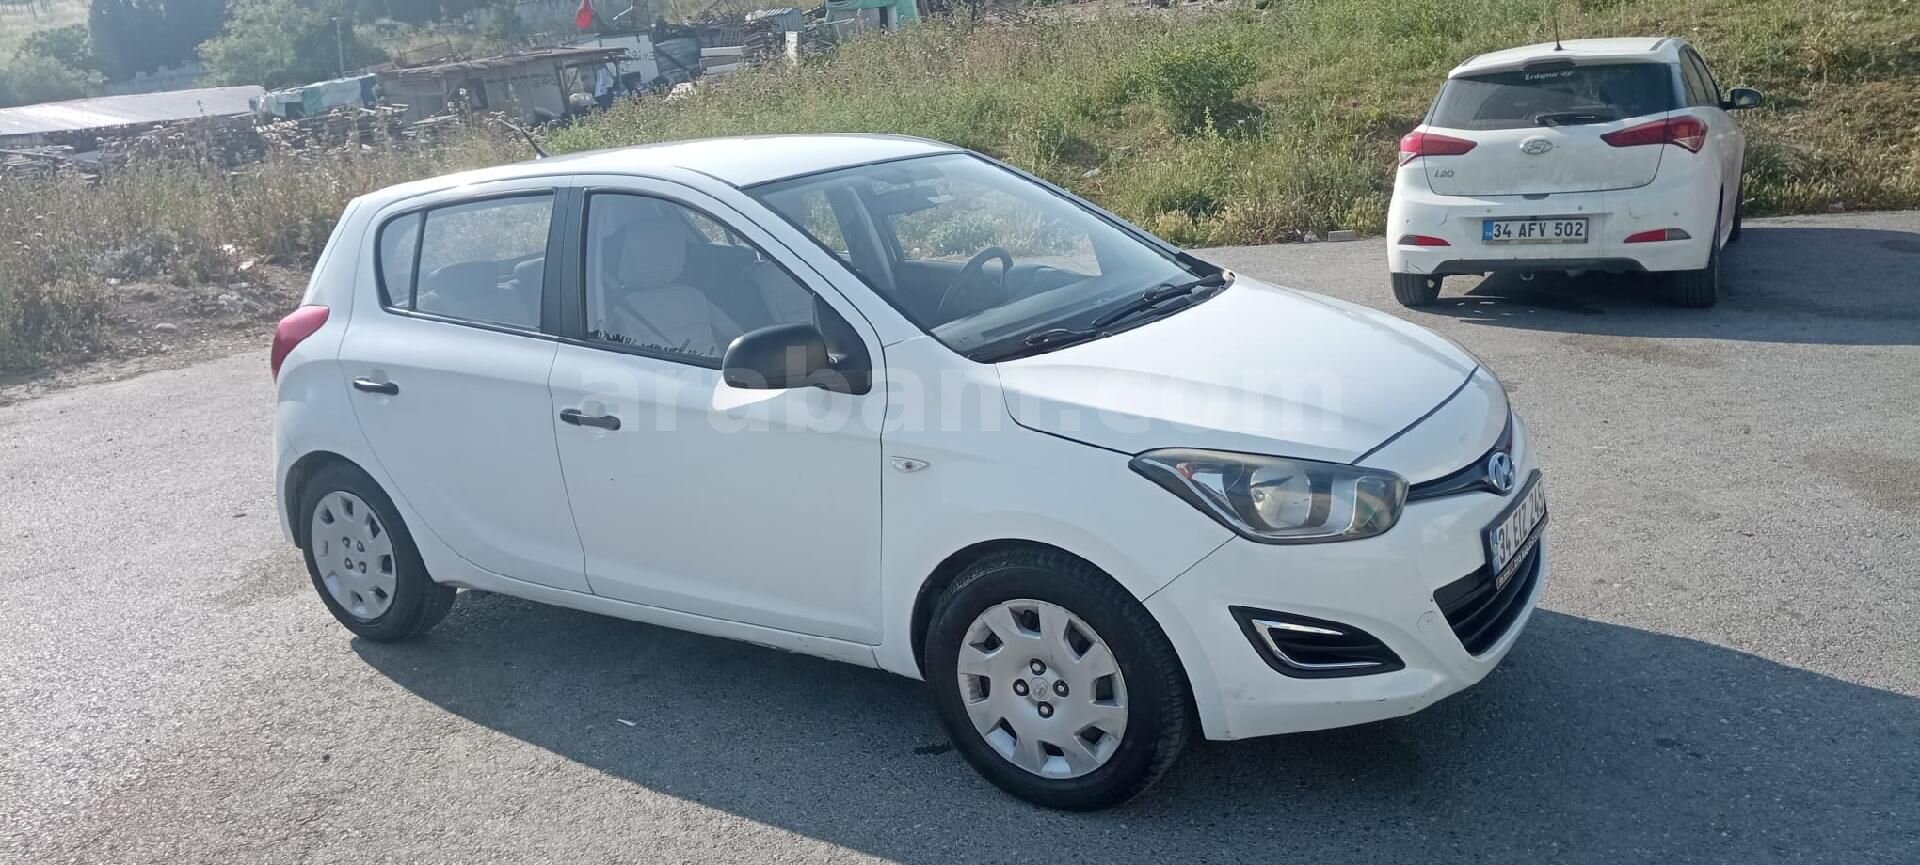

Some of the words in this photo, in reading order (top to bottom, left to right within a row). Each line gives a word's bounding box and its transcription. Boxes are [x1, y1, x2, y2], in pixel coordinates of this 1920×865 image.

[1494, 223, 1512, 238] 34
[1518, 222, 1547, 238] AFV
[1554, 221, 1583, 237] 502
[1498, 523, 1512, 565] 34
